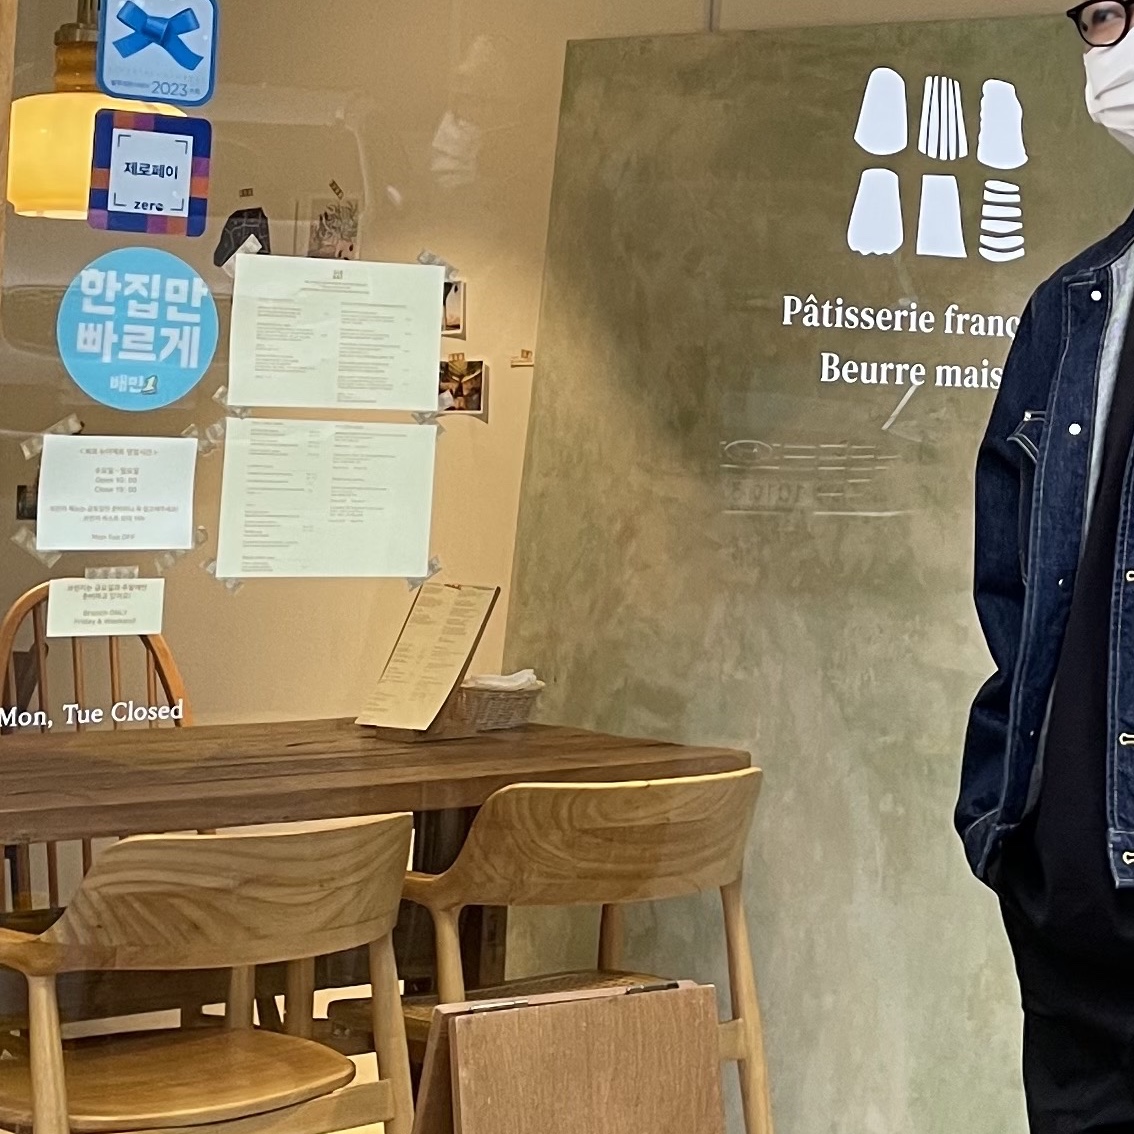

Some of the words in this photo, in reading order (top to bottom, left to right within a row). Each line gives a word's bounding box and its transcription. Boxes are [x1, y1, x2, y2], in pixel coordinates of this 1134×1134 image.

[151, 80, 188, 97] 2023
[124, 161, 179, 179] 제로페이
[133, 200, 164, 212] zero
[80, 268, 209, 323] 한집만
[781, 293, 935, 333] Pâtisserie
[76, 320, 201, 369] 빠르게
[820, 352, 926, 386] Beurre
[935, 359, 1003, 390] mais
[0, 706, 53, 729] Mon,
[62, 703, 104, 725] Tue
[111, 699, 184, 722] Closed
